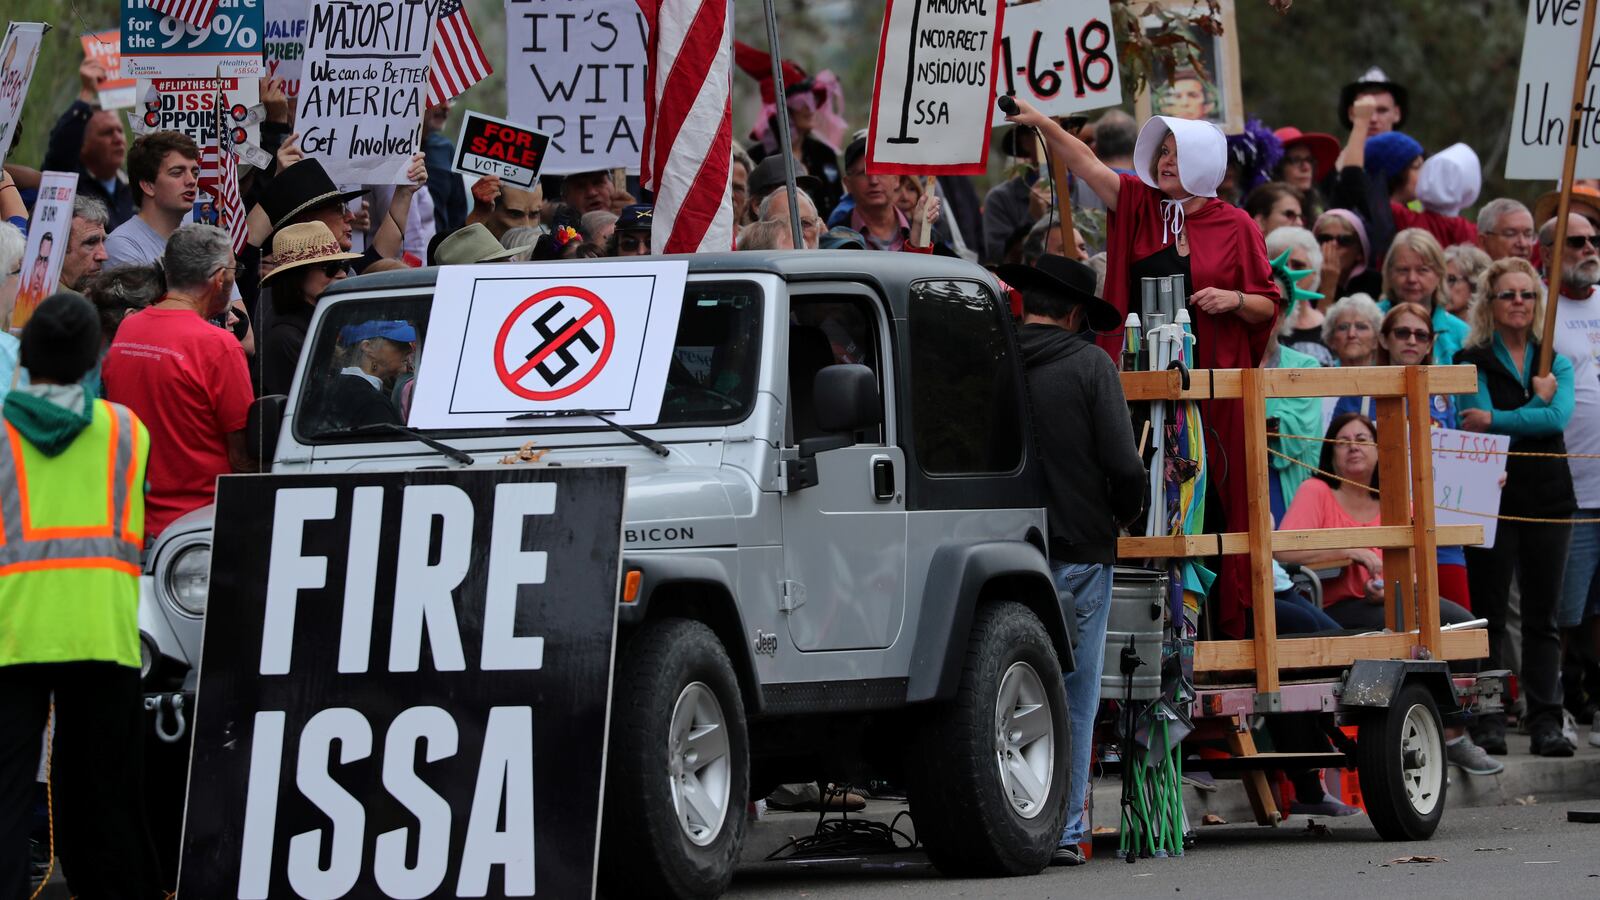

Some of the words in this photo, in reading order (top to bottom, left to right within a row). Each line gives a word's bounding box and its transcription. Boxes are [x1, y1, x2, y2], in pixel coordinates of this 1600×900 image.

[128, 17, 153, 31] for
[309, 0, 439, 52] MAJORITY
[1536, 0, 1581, 26] We
[128, 33, 155, 48] the
[159, 14, 258, 49] 99%
[522, 9, 618, 52] IT'S
[919, 29, 988, 51] NCORRECT
[265, 42, 305, 61] PREP
[311, 60, 337, 82] We
[338, 68, 360, 81] can
[362, 63, 378, 80] do
[382, 61, 430, 84] BETTER
[530, 63, 648, 103] WIT
[301, 85, 420, 119] AMERICA
[914, 99, 949, 125] SSA
[301, 126, 337, 155] Get
[349, 123, 421, 159] Involved!
[484, 123, 533, 148] FOR
[470, 136, 537, 167] SALE
[474, 157, 519, 177] VOTES
[259, 482, 558, 676] FIRE
[754, 629, 778, 658] Jeep
[237, 705, 536, 900] ISSA
